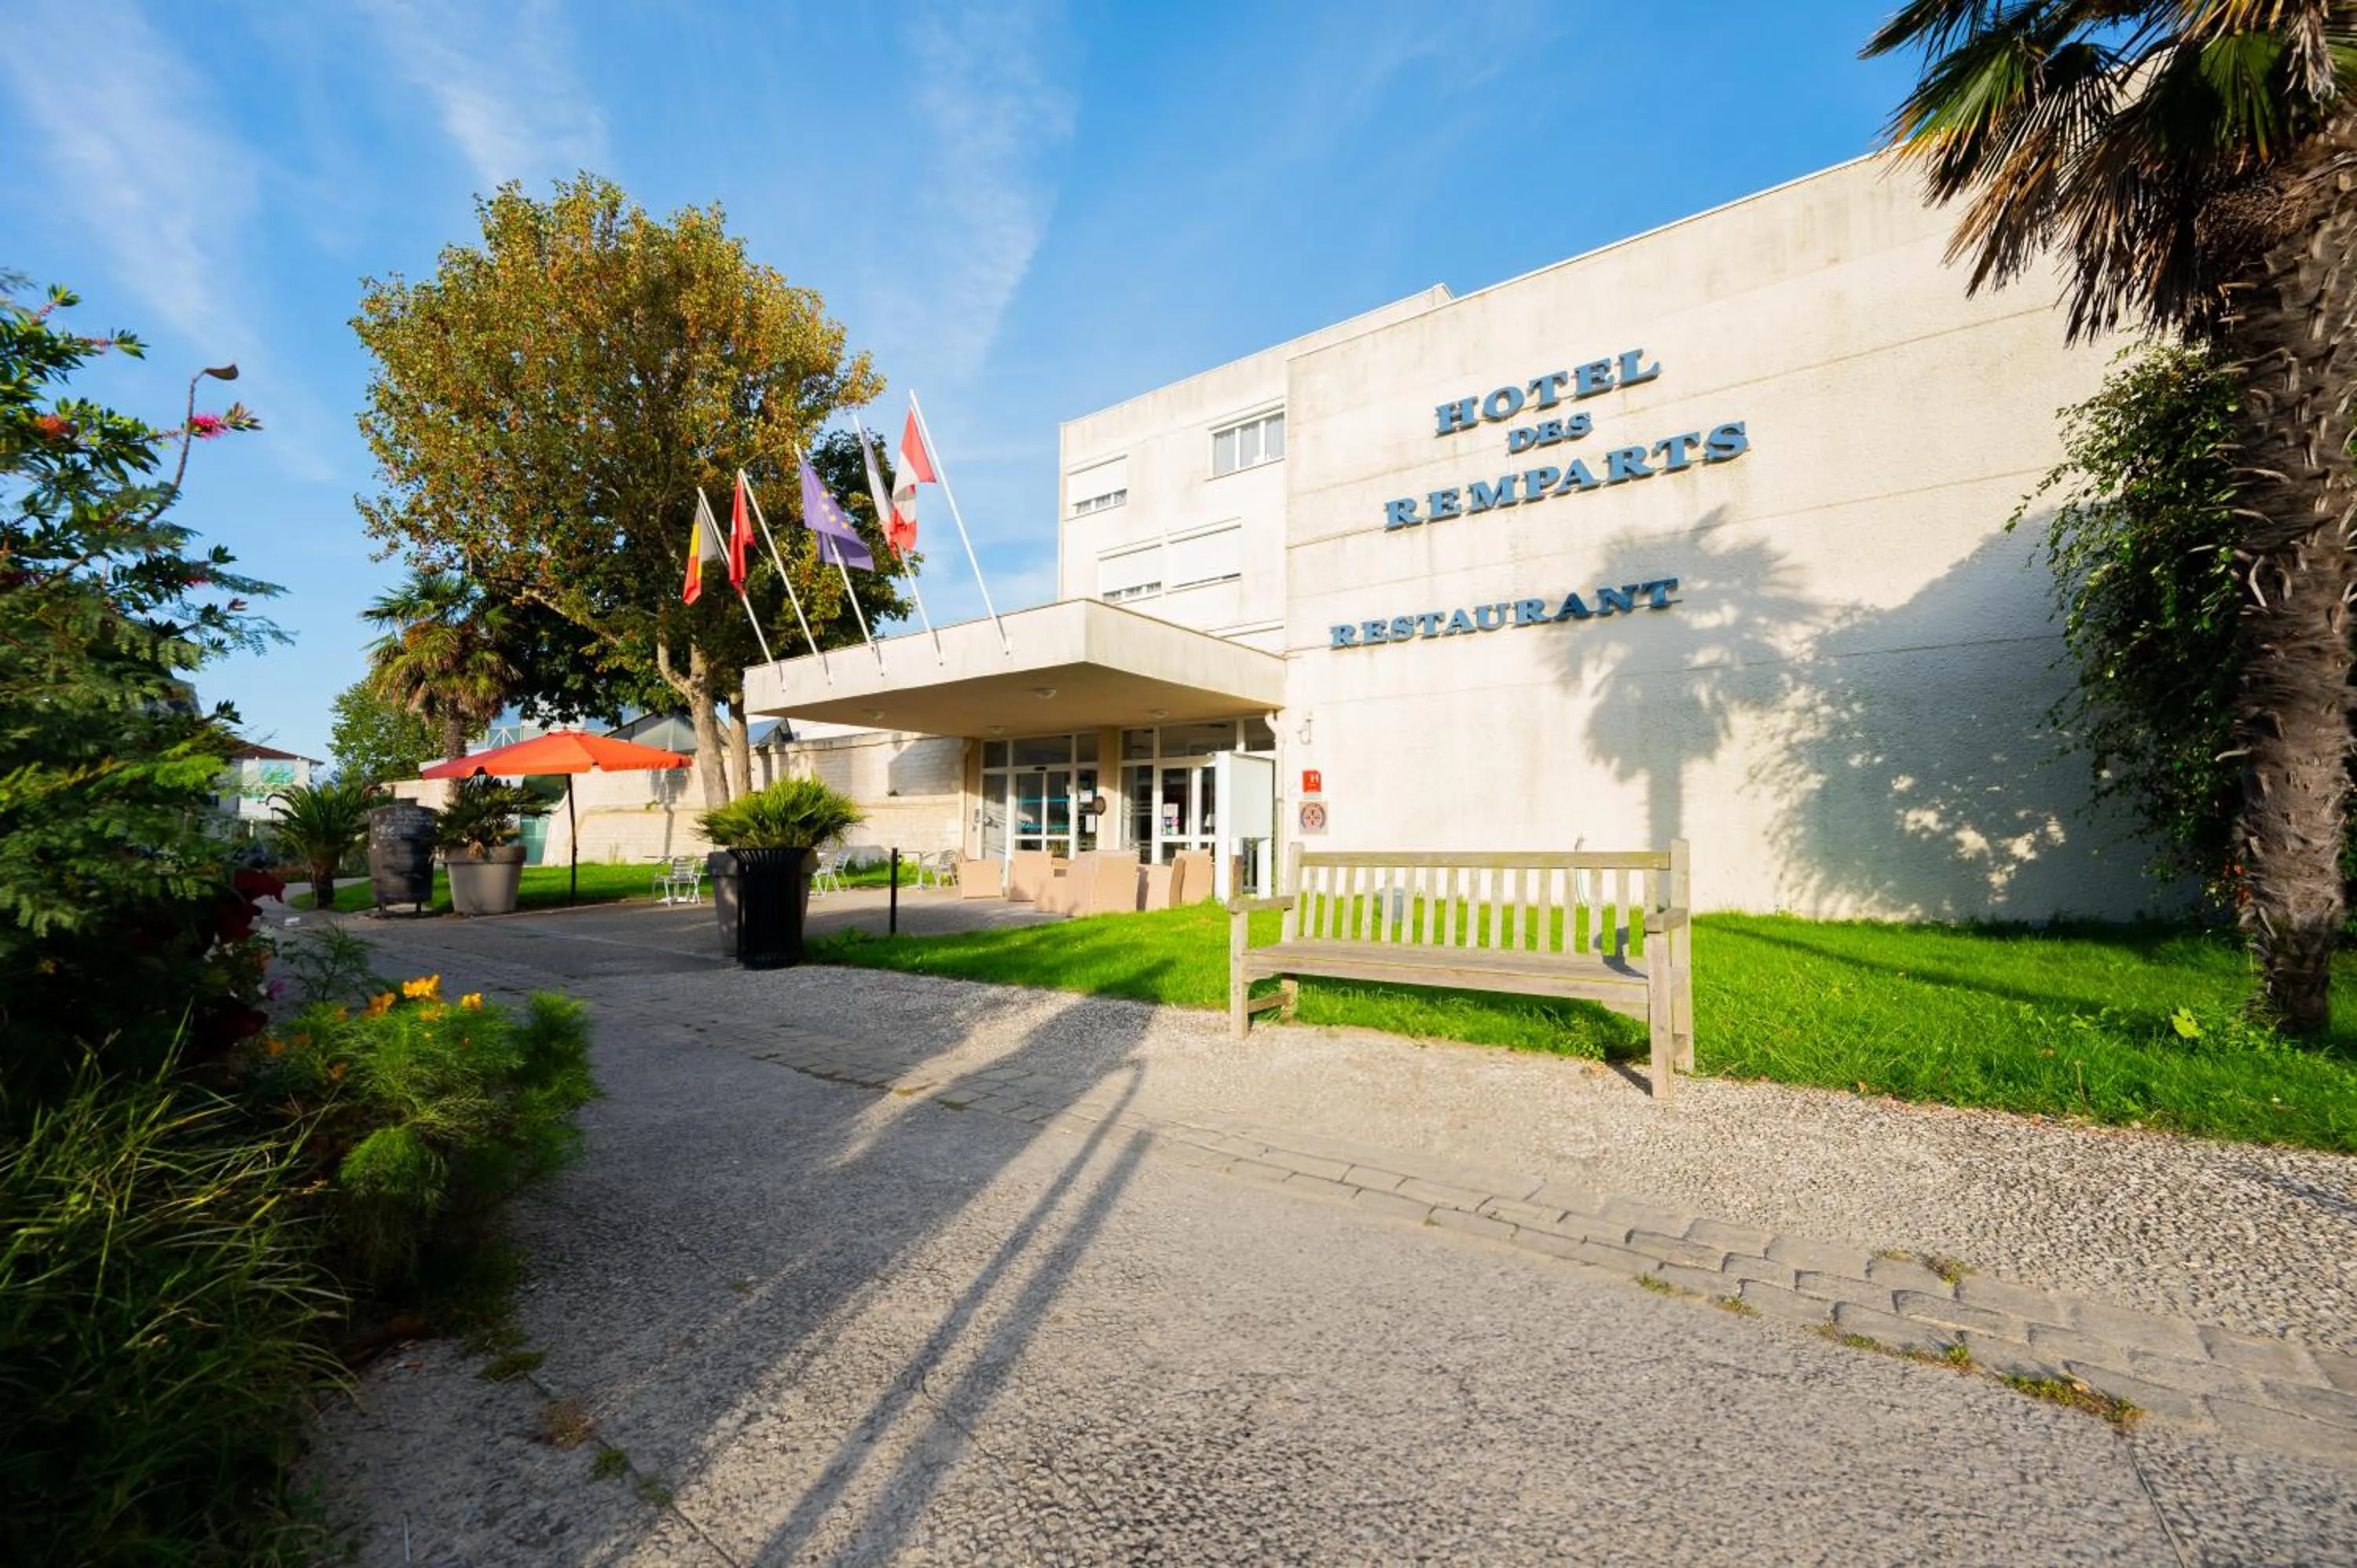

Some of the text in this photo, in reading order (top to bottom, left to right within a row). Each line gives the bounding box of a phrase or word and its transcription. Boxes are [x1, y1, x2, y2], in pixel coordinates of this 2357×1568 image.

[1435, 349, 1660, 436] HOTEL
[1508, 412, 1593, 455] DES
[1384, 421, 1751, 530] REMPARTS
[1330, 578, 1680, 650] RESTAURANT
